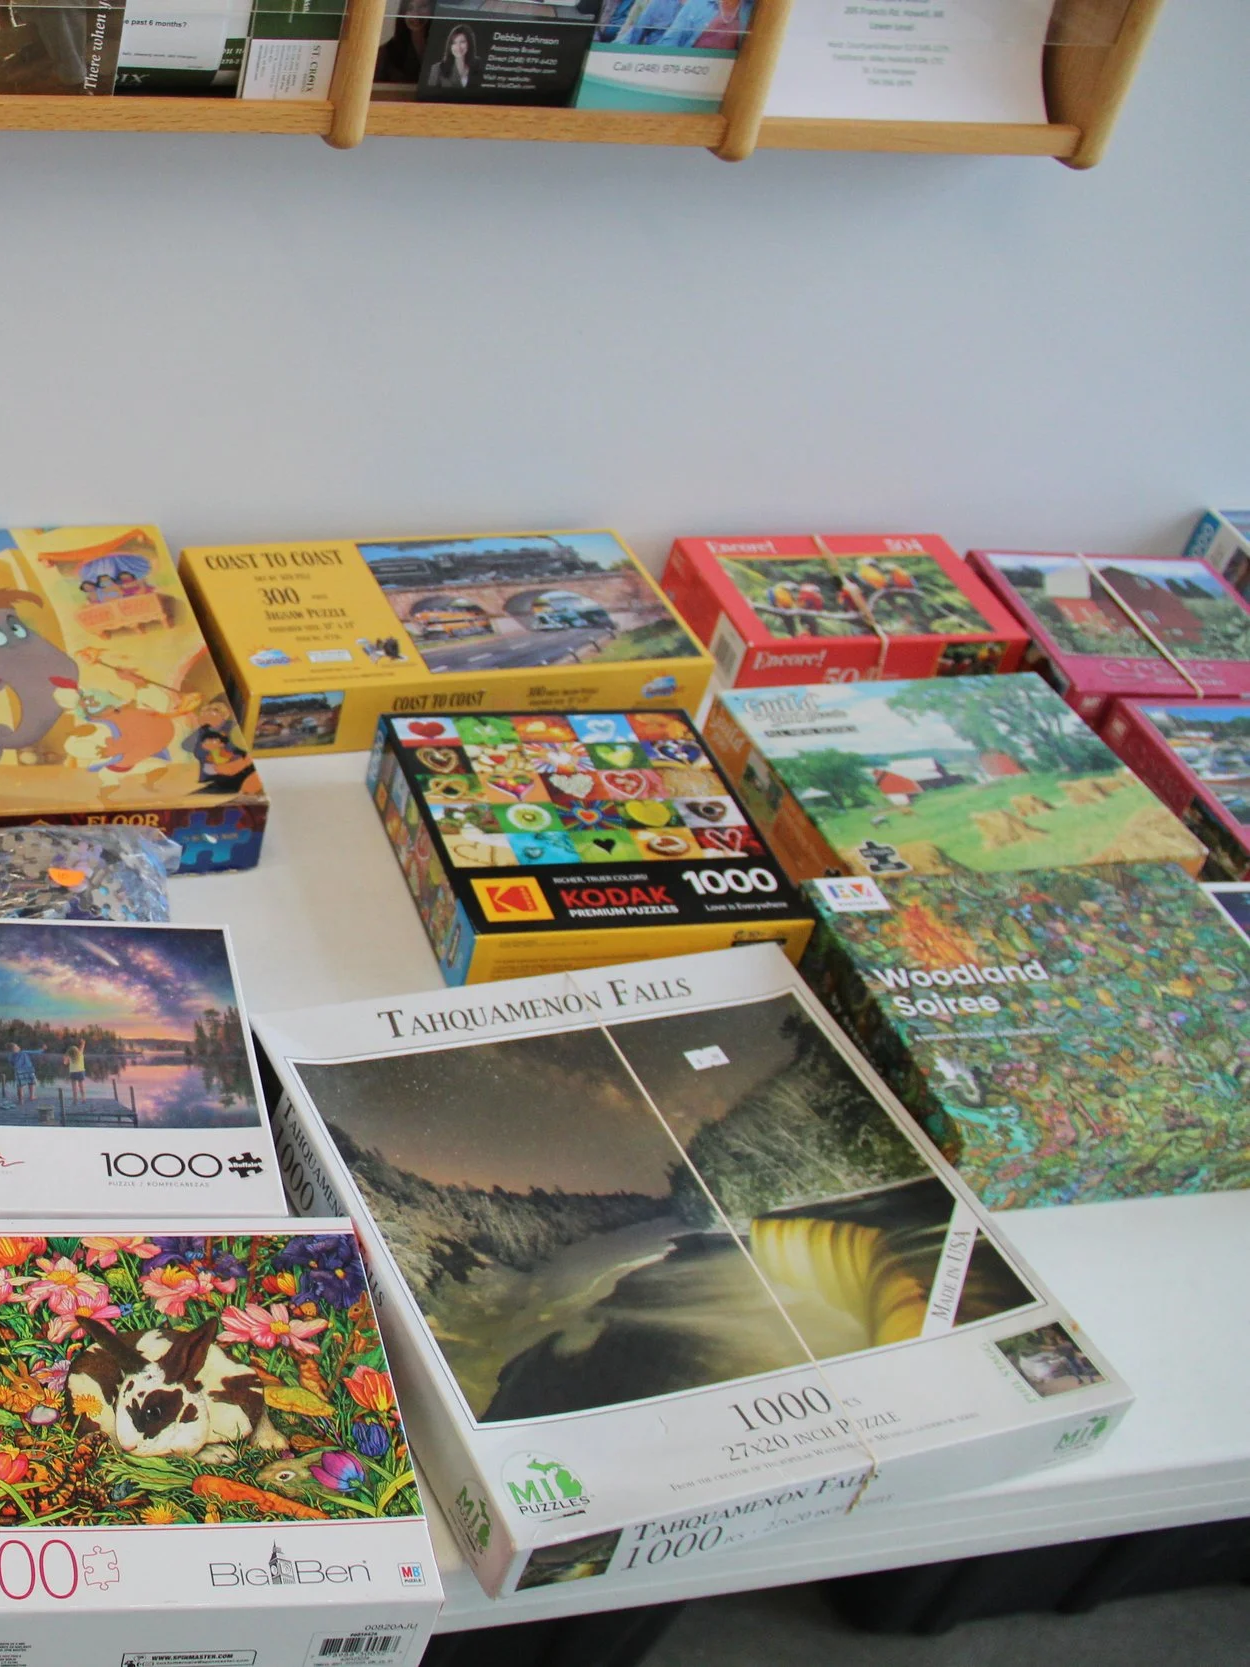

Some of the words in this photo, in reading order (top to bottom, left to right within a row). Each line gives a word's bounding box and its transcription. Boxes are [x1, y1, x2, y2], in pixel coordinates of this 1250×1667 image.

[131, 20, 147, 28] past
[155, 20, 187, 28] months?
[493, 32, 523, 43] Debbie
[525, 34, 559, 45] Johnson
[83, 53, 100, 91] There
[93, 12, 108, 51] when
[613, 61, 632, 72] Call
[205, 554, 258, 570] COAST
[260, 552, 287, 567] TO
[290, 549, 344, 567] COAST
[258, 587, 300, 605] 300
[265, 611, 304, 621] JIGSAW
[307, 607, 347, 619] PUZZLE
[753, 650, 828, 671] Encore!
[392, 696, 429, 711] COAST
[430, 694, 448, 708] TO
[450, 690, 486, 707] COAST
[560, 885, 675, 908] KODAK
[682, 867, 779, 896] 1000
[586, 875, 612, 883] TRUER
[569, 905, 626, 918] PREMIUM
[627, 904, 680, 916] PUZZLES
[705, 903, 727, 912] Love
[736, 900, 789, 912] Everywhere
[874, 959, 1049, 990] Woodland
[378, 990, 601, 1039] TAHQUAMENON
[607, 976, 693, 1008] FALLS
[892, 992, 1002, 1018] Soiree
[100, 1152, 223, 1178] 1000
[283, 1097, 344, 1217] TAHQUAMEN
[946, 1231, 971, 1262] USA
[946, 1261, 961, 1277] IN
[931, 1276, 959, 1321] MADE
[728, 1385, 832, 1433] 1000
[793, 1424, 836, 1446] INCH
[518, 1495, 591, 1515] PUZZLES
[634, 1487, 806, 1541] TAHQUAMENON
[620, 1525, 723, 1572] 1000
[209, 1561, 268, 1588] Big
[295, 1559, 371, 1584] Ben
[401, 1566, 421, 1578] MB
[151, 1653, 234, 1661] WWW.SPINMASTER.COM
